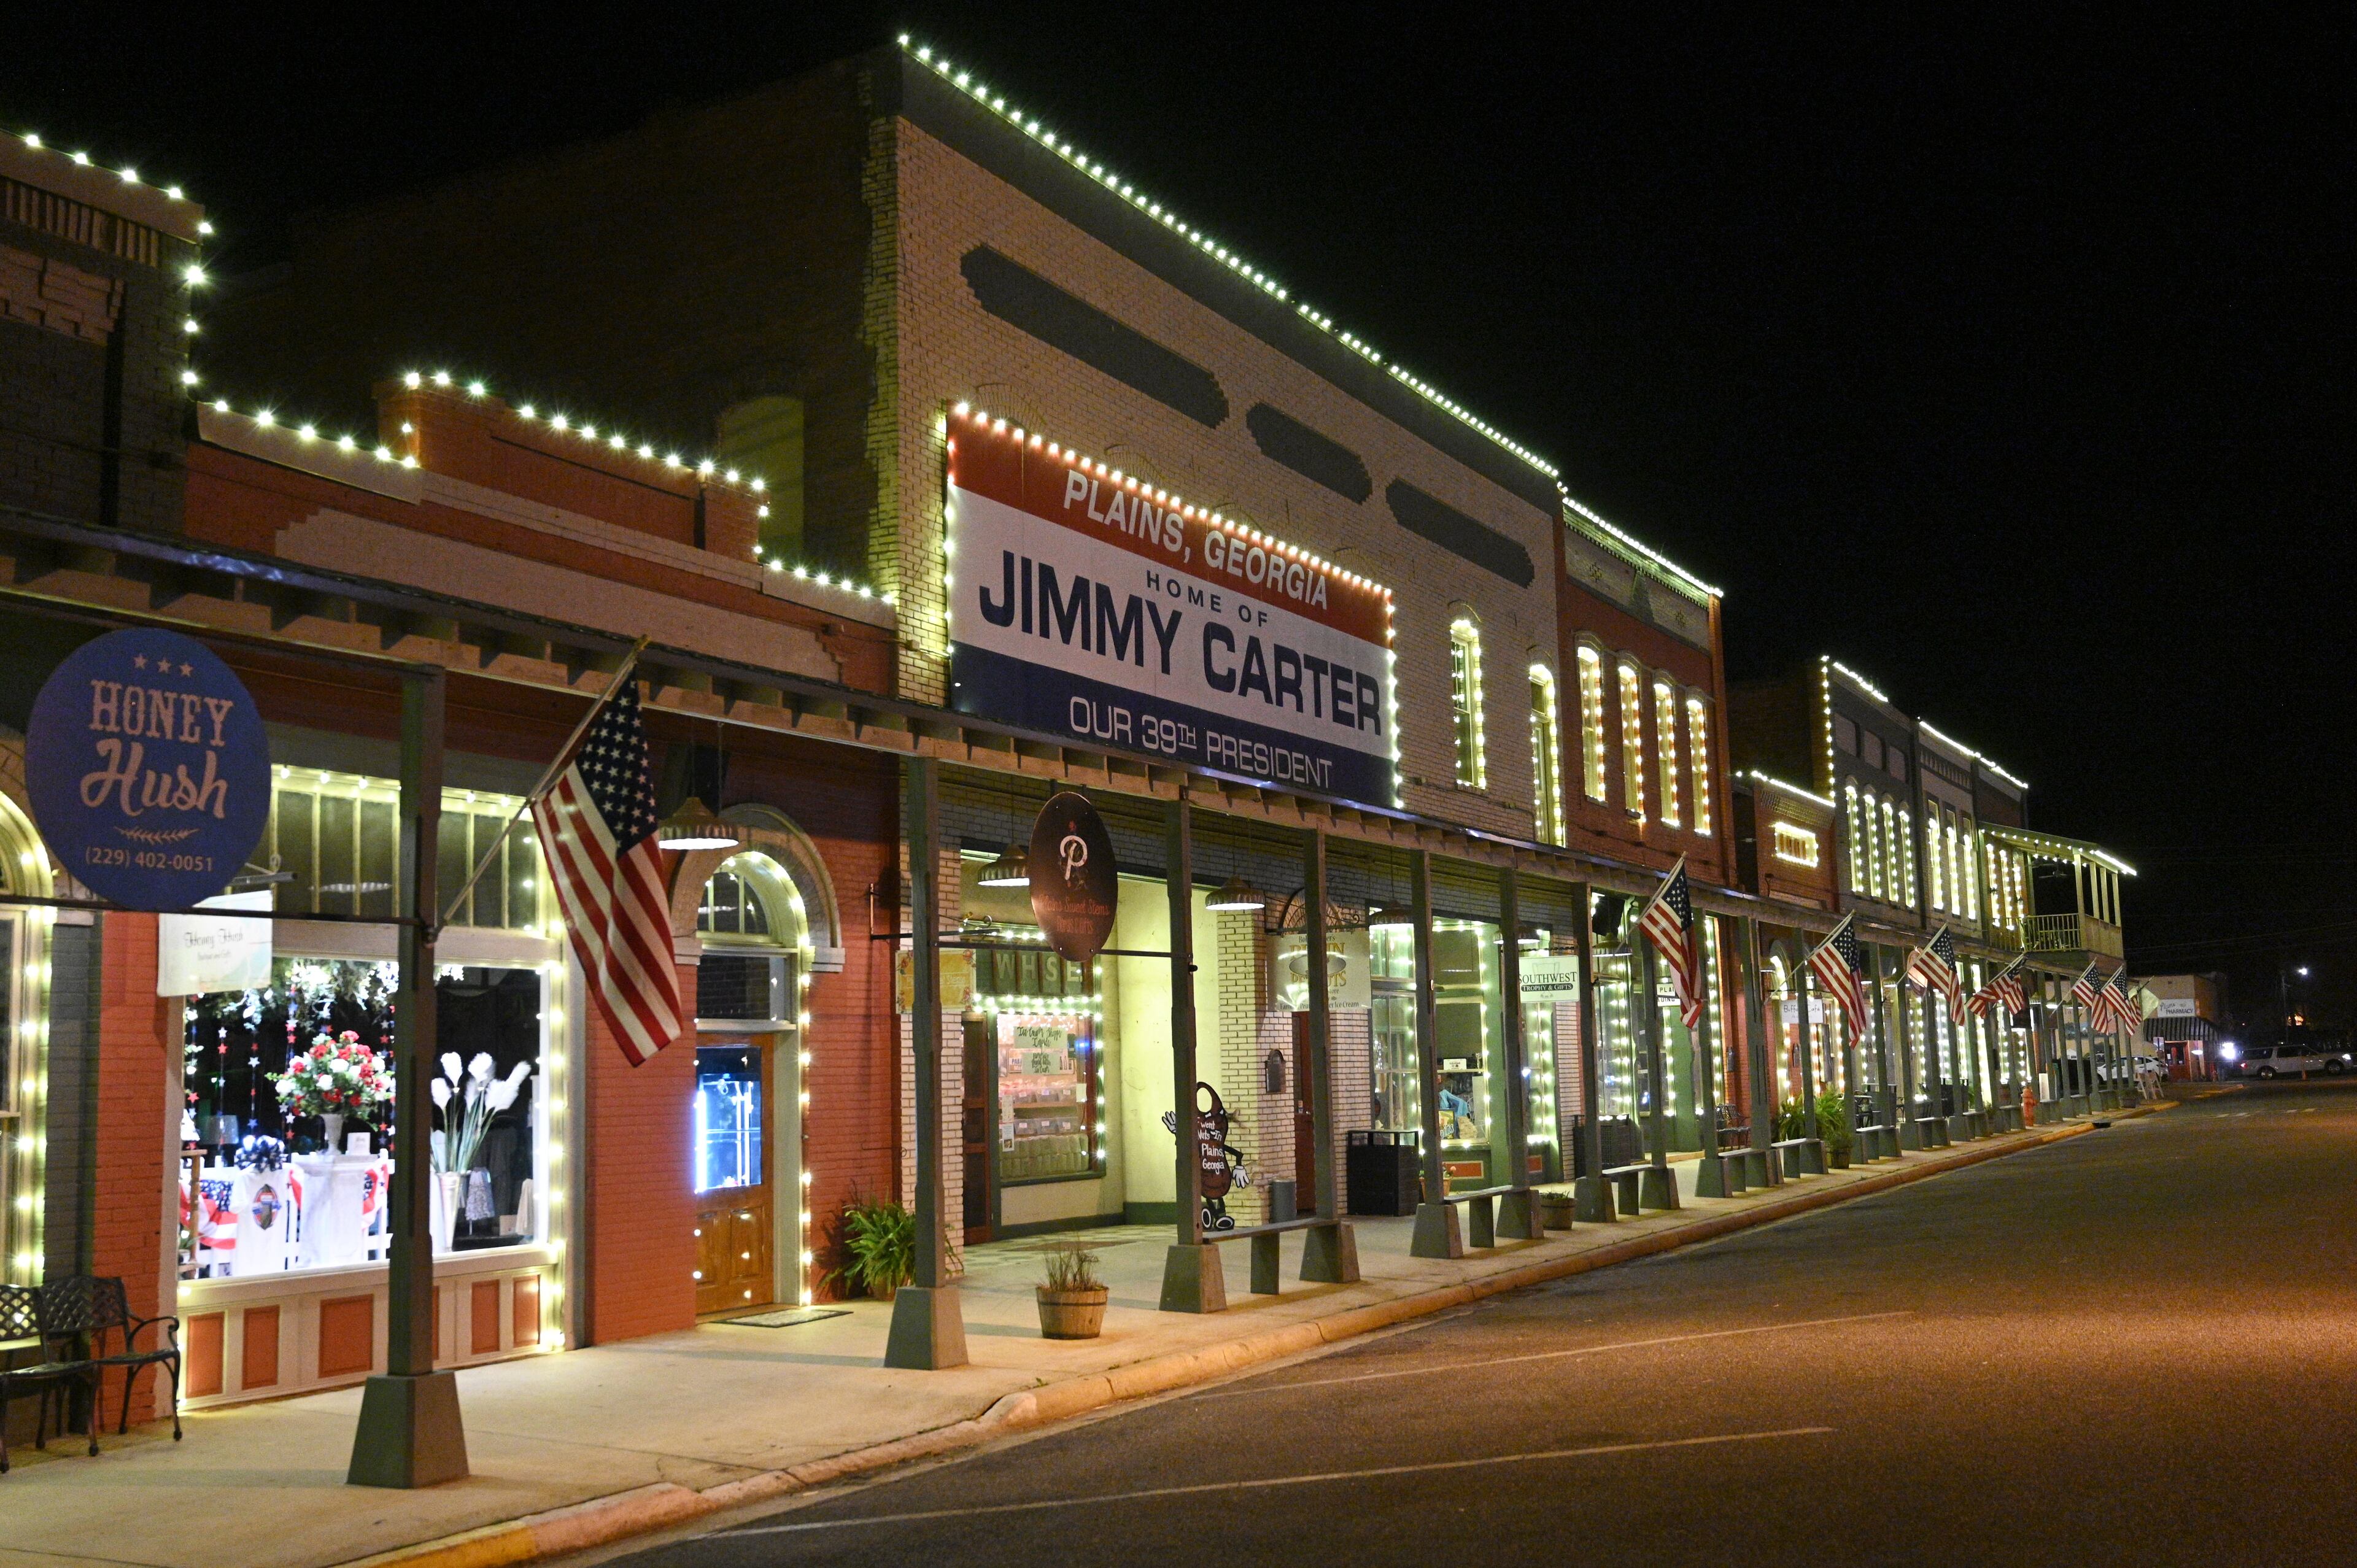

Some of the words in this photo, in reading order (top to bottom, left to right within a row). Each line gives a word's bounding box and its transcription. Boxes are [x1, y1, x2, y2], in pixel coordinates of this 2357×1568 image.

[1063, 469, 1190, 563] PLAINS,
[1204, 530, 1327, 609] GEORGIA
[1147, 570, 1221, 613] HOME
[1238, 604, 1268, 627] OF
[980, 550, 1182, 675] JIMMY
[1203, 622, 1381, 735] CARTER
[89, 679, 234, 747] HONEY
[1070, 696, 1131, 743] OUR
[1207, 732, 1332, 790] PRESIDENT
[80, 738, 228, 819] Hush
[85, 846, 130, 868] (229)
[134, 851, 213, 872] 402-0051
[1064, 896, 1086, 914] Sweet
[184, 931, 215, 949] Honey
[217, 927, 244, 944] Hush
[1198, 1129, 1210, 1140] Nuts
[1214, 1130, 1222, 1141] In
[1201, 1121, 1215, 1130] went
[1202, 1143, 1225, 1157] Plains,
[1202, 1158, 1225, 1175] Georgia
